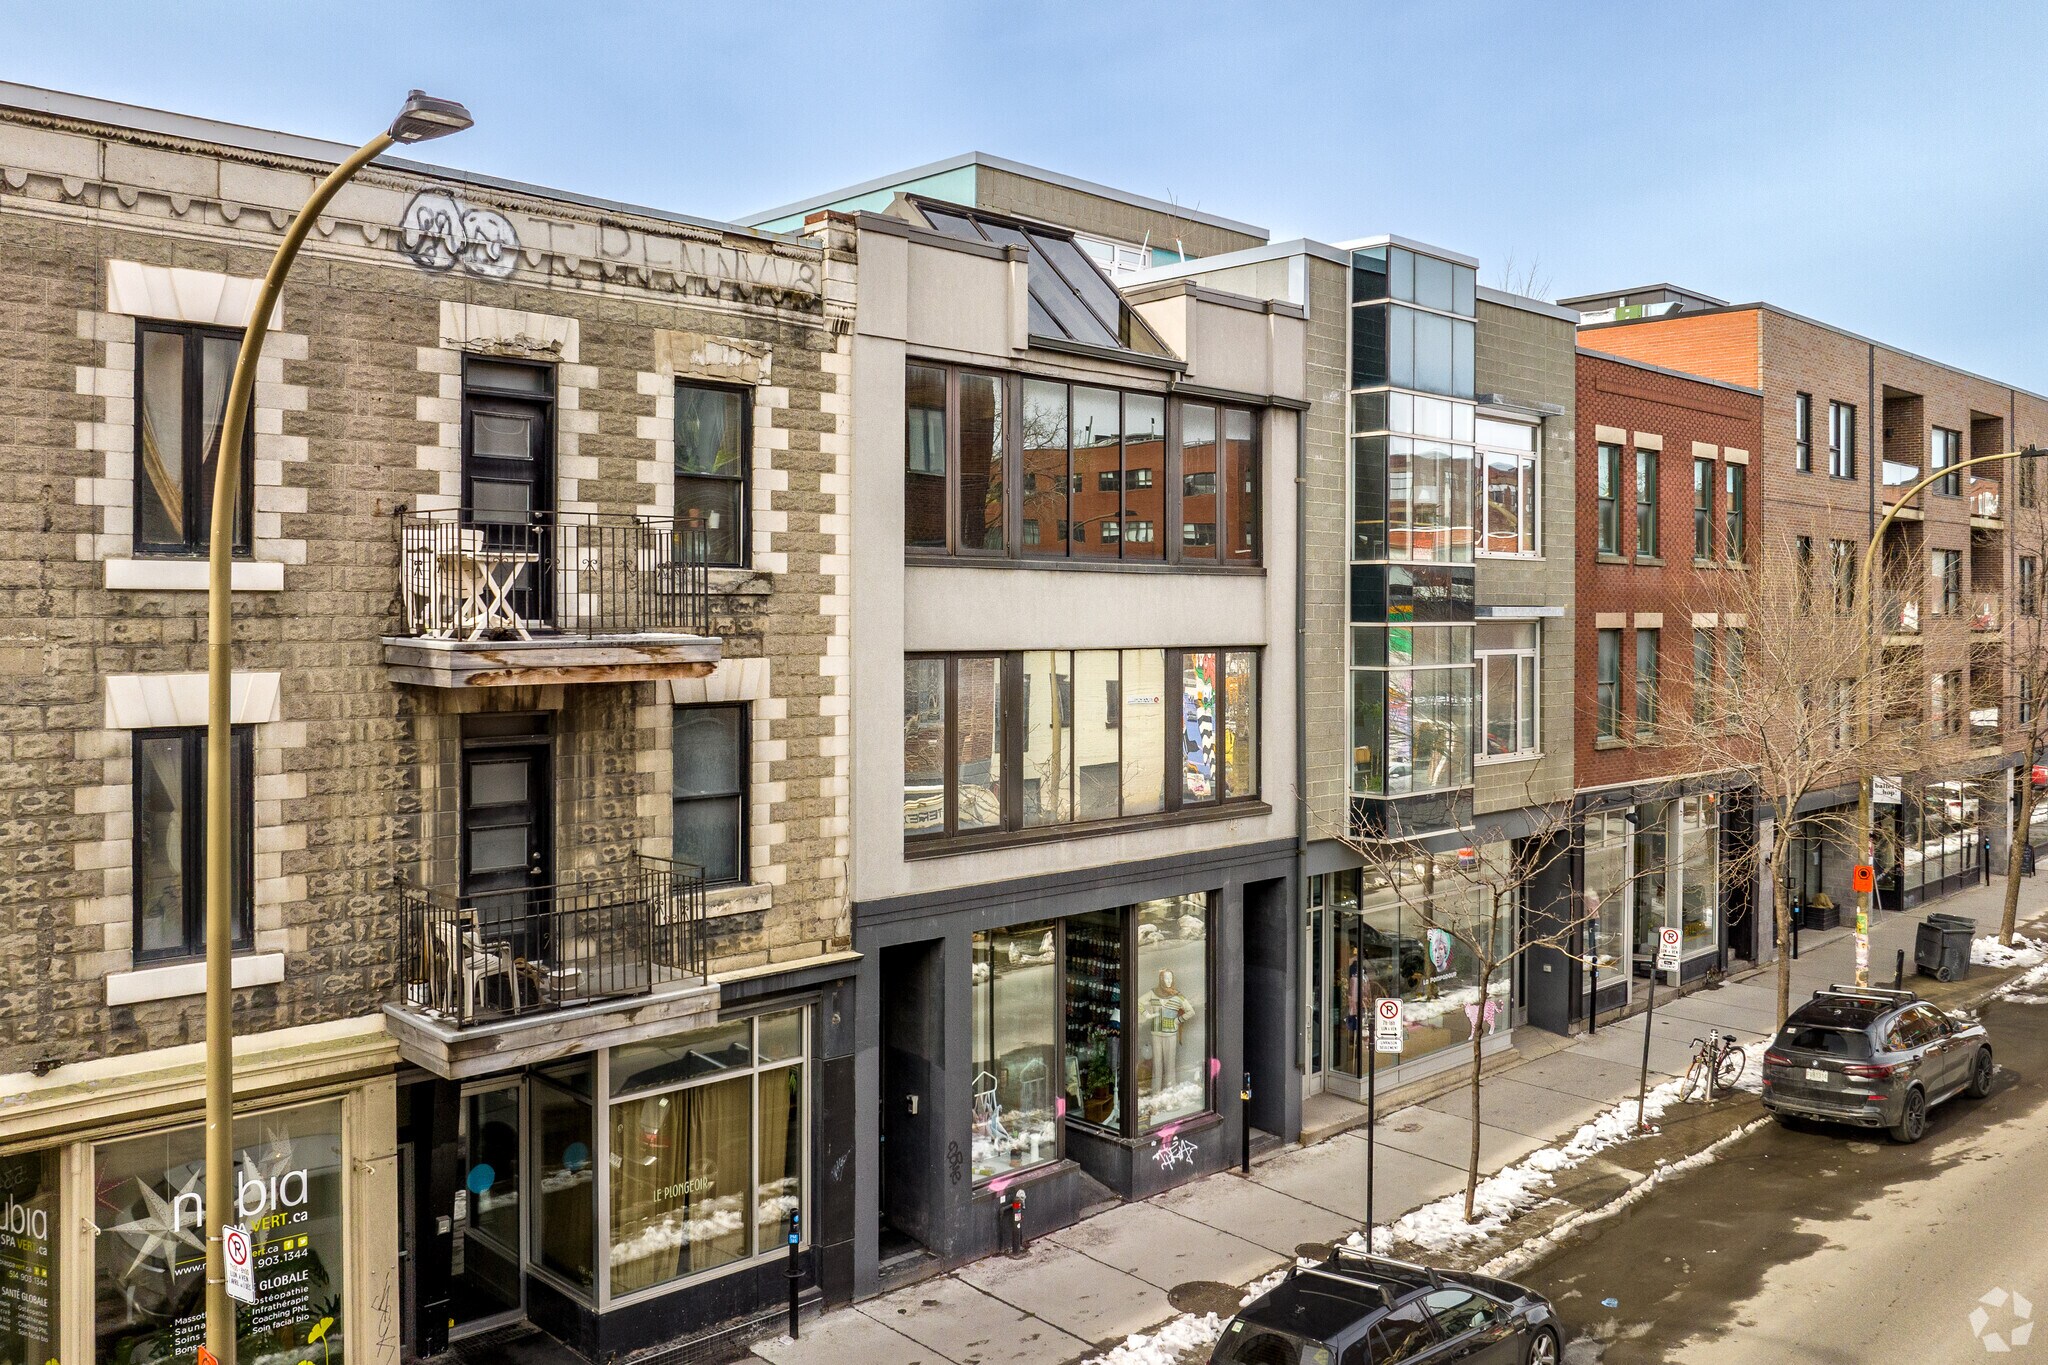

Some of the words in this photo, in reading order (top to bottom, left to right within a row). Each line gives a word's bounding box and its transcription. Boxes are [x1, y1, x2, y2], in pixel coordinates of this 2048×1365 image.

[653, 1188, 662, 1203] LE
[664, 1176, 709, 1199] PLONGEOIR
[173, 1168, 308, 1233] nbia
[0, 1193, 47, 1241] ubia
[251, 1210, 308, 1232] VERT.ca
[0, 1234, 16, 1248] SPA
[254, 1248, 309, 1269] .903.1344
[259, 1269, 309, 1291] GLOBALE
[1, 1286, 20, 1300] SANTÉ
[21, 1292, 48, 1308] GLOBALE
[252, 1295, 309, 1316] Infrathérapie
[254, 1285, 309, 1306] Ostéopathie
[174, 1311, 206, 1326] Massot
[252, 1309, 290, 1326] Coaching
[292, 1305, 309, 1315] PNL
[252, 1323, 271, 1335] Soin
[272, 1318, 295, 1330] facial
[296, 1313, 310, 1323] bio
[174, 1323, 206, 1336] Sauna
[174, 1333, 200, 1347] Soins
[174, 1341, 206, 1356] Bons-c
